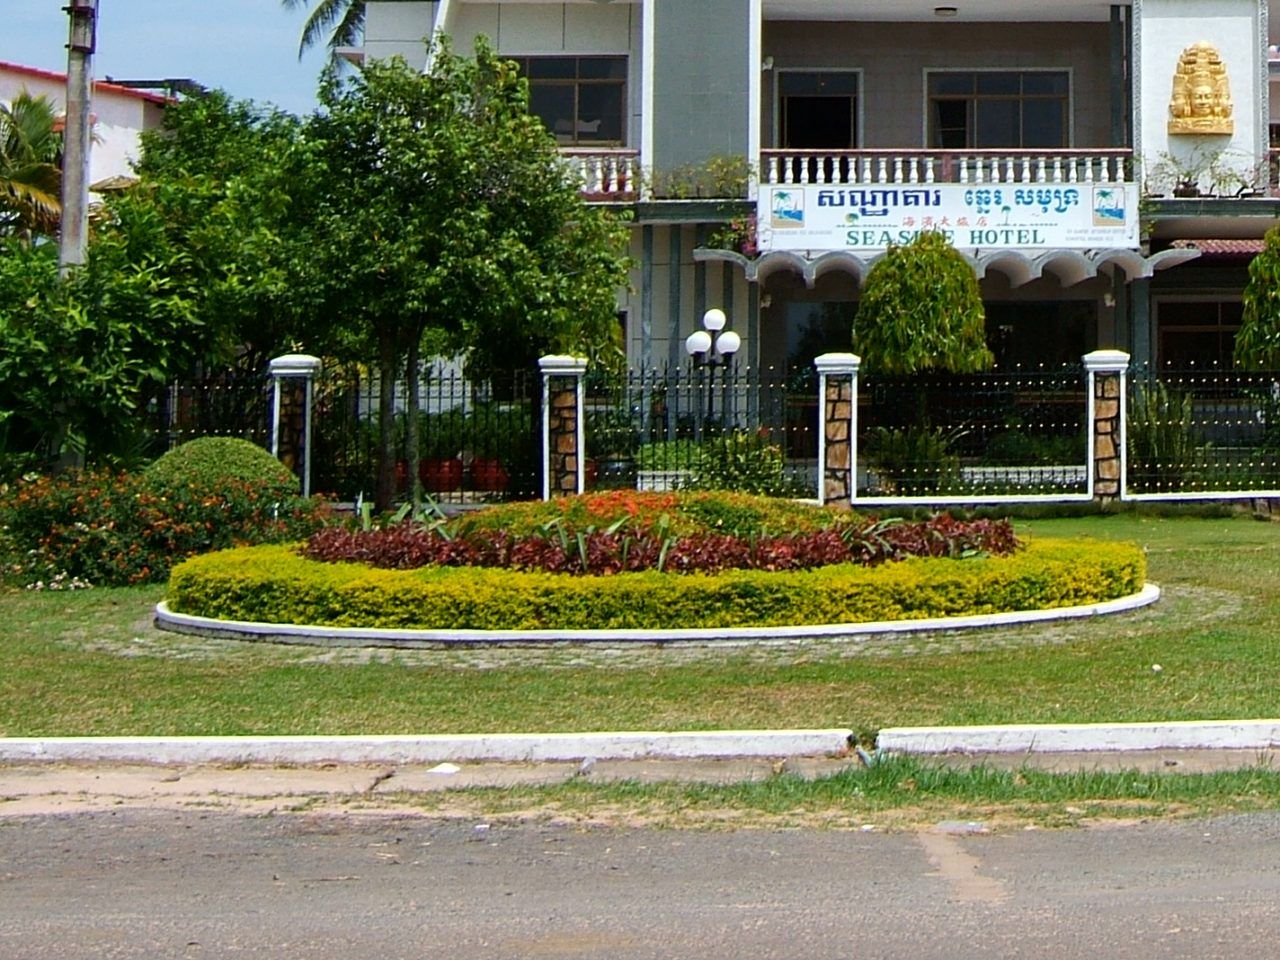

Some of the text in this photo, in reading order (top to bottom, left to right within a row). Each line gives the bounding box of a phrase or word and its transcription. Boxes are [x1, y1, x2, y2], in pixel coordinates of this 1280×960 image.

[1014, 188, 1080, 214] សមុទ្រ
[846, 230, 955, 246] SEASIE
[969, 229, 1046, 245] HOTEL
